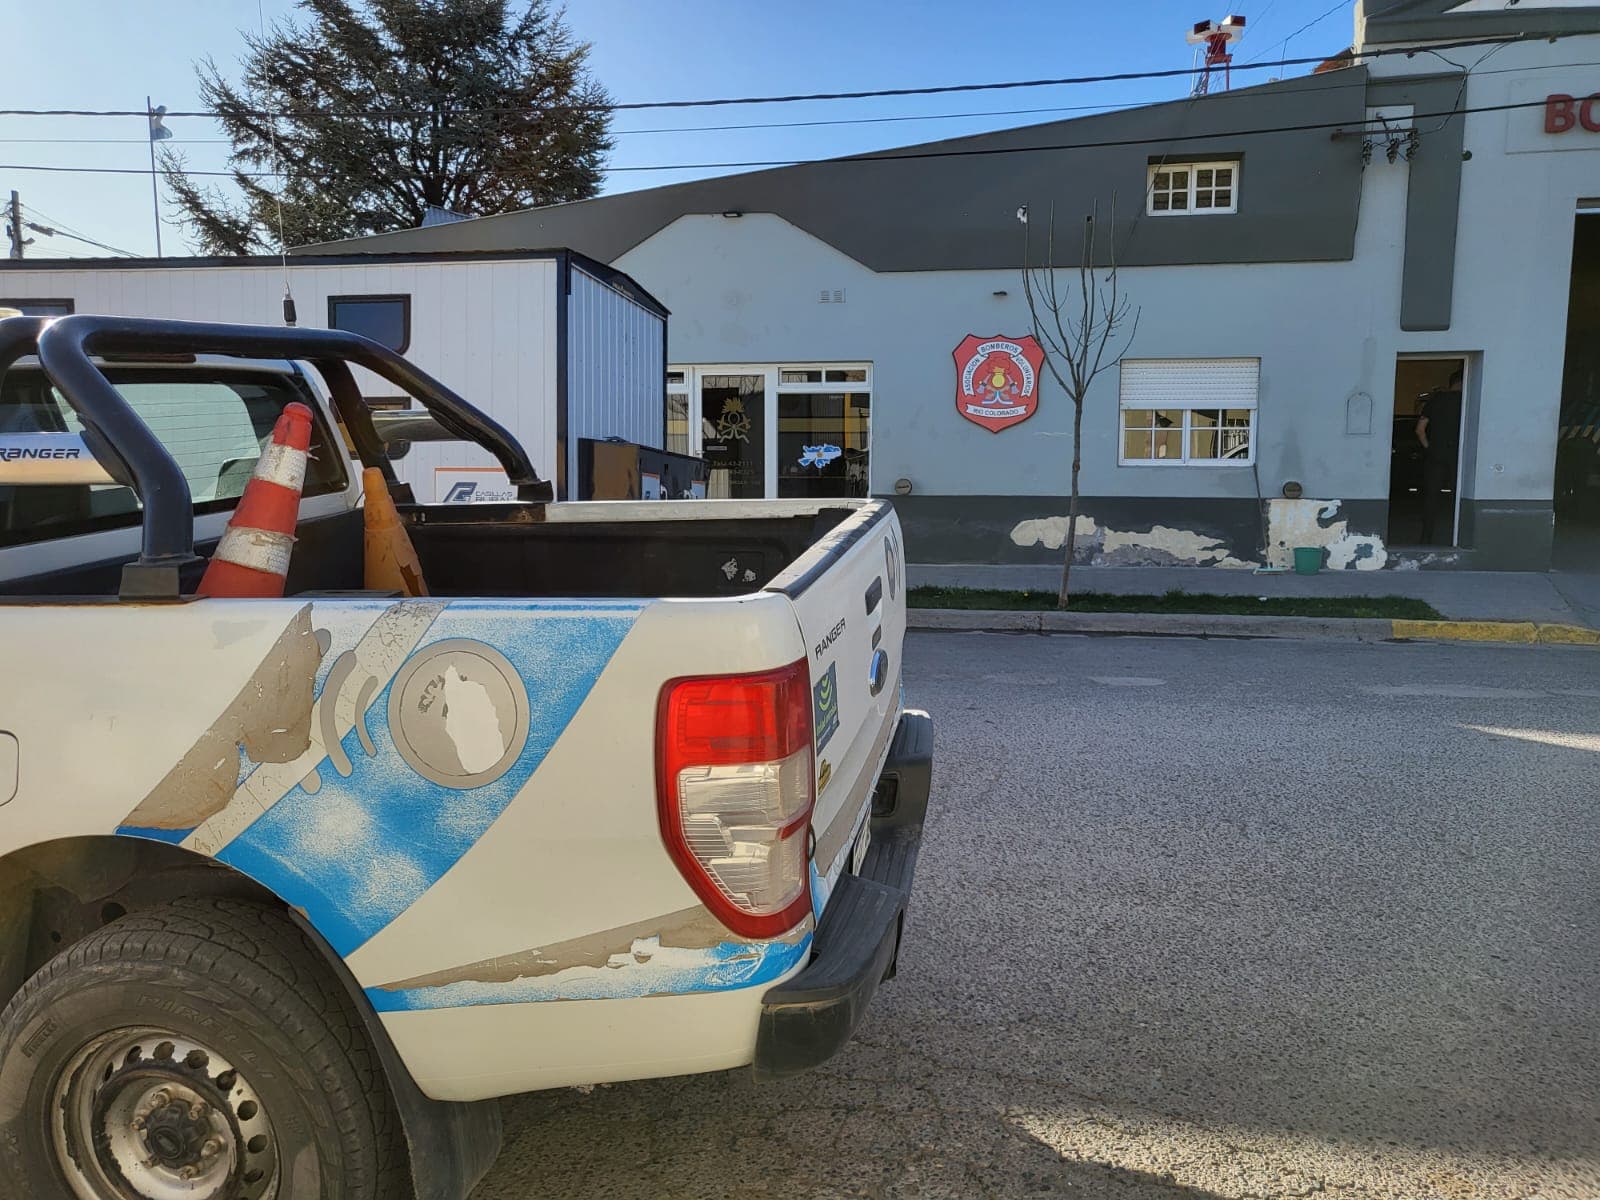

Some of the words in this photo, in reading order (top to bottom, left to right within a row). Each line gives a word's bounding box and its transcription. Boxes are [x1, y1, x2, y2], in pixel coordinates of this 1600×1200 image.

[980, 343, 1019, 354] BOMBEROS
[985, 408, 1019, 417] COLORADO
[815, 617, 846, 661] RANGER
